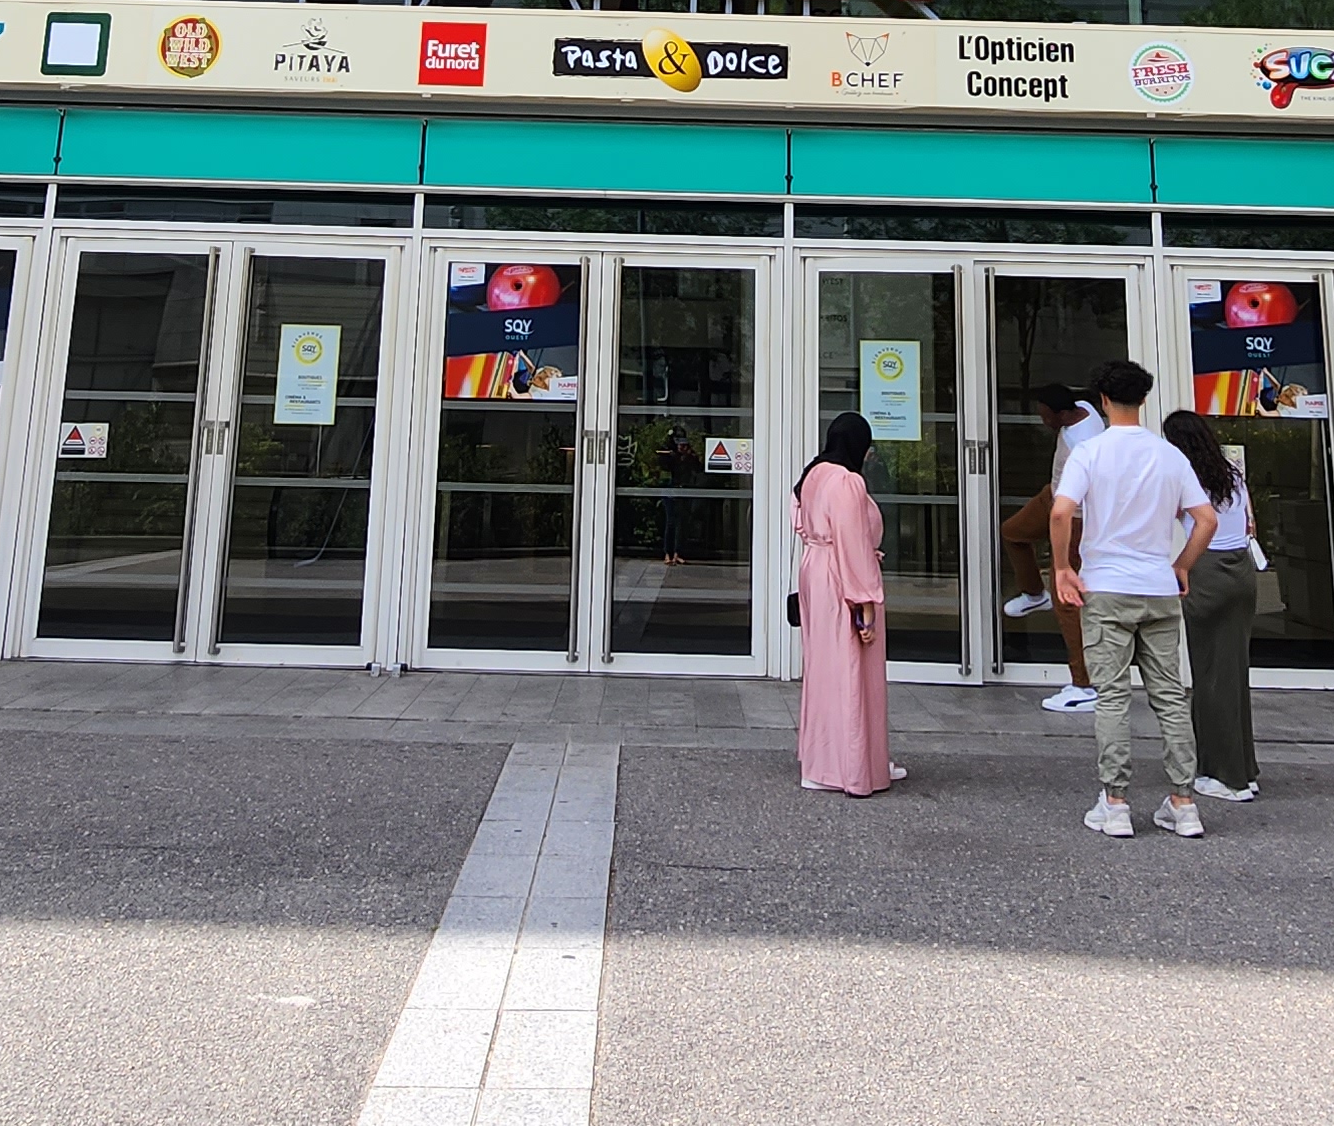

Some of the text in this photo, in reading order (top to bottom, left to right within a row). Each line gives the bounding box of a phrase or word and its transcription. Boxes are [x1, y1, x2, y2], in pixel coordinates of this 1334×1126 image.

[174, 23, 208, 37] OLD
[169, 37, 211, 52] WILD
[427, 39, 480, 58] Furet
[959, 34, 1075, 64] L'Opticien
[166, 52, 212, 67] WEST
[425, 55, 480, 71] du nord
[658, 40, 690, 76] &
[1132, 62, 1189, 78] FRESH
[967, 70, 1069, 102] Concept
[1134, 73, 1191, 87] BURRITOS
[504, 319, 534, 334] SQY
[302, 345, 317, 353] SQY
[1246, 337, 1275, 352] SQY
[882, 361, 898, 369] SQY
